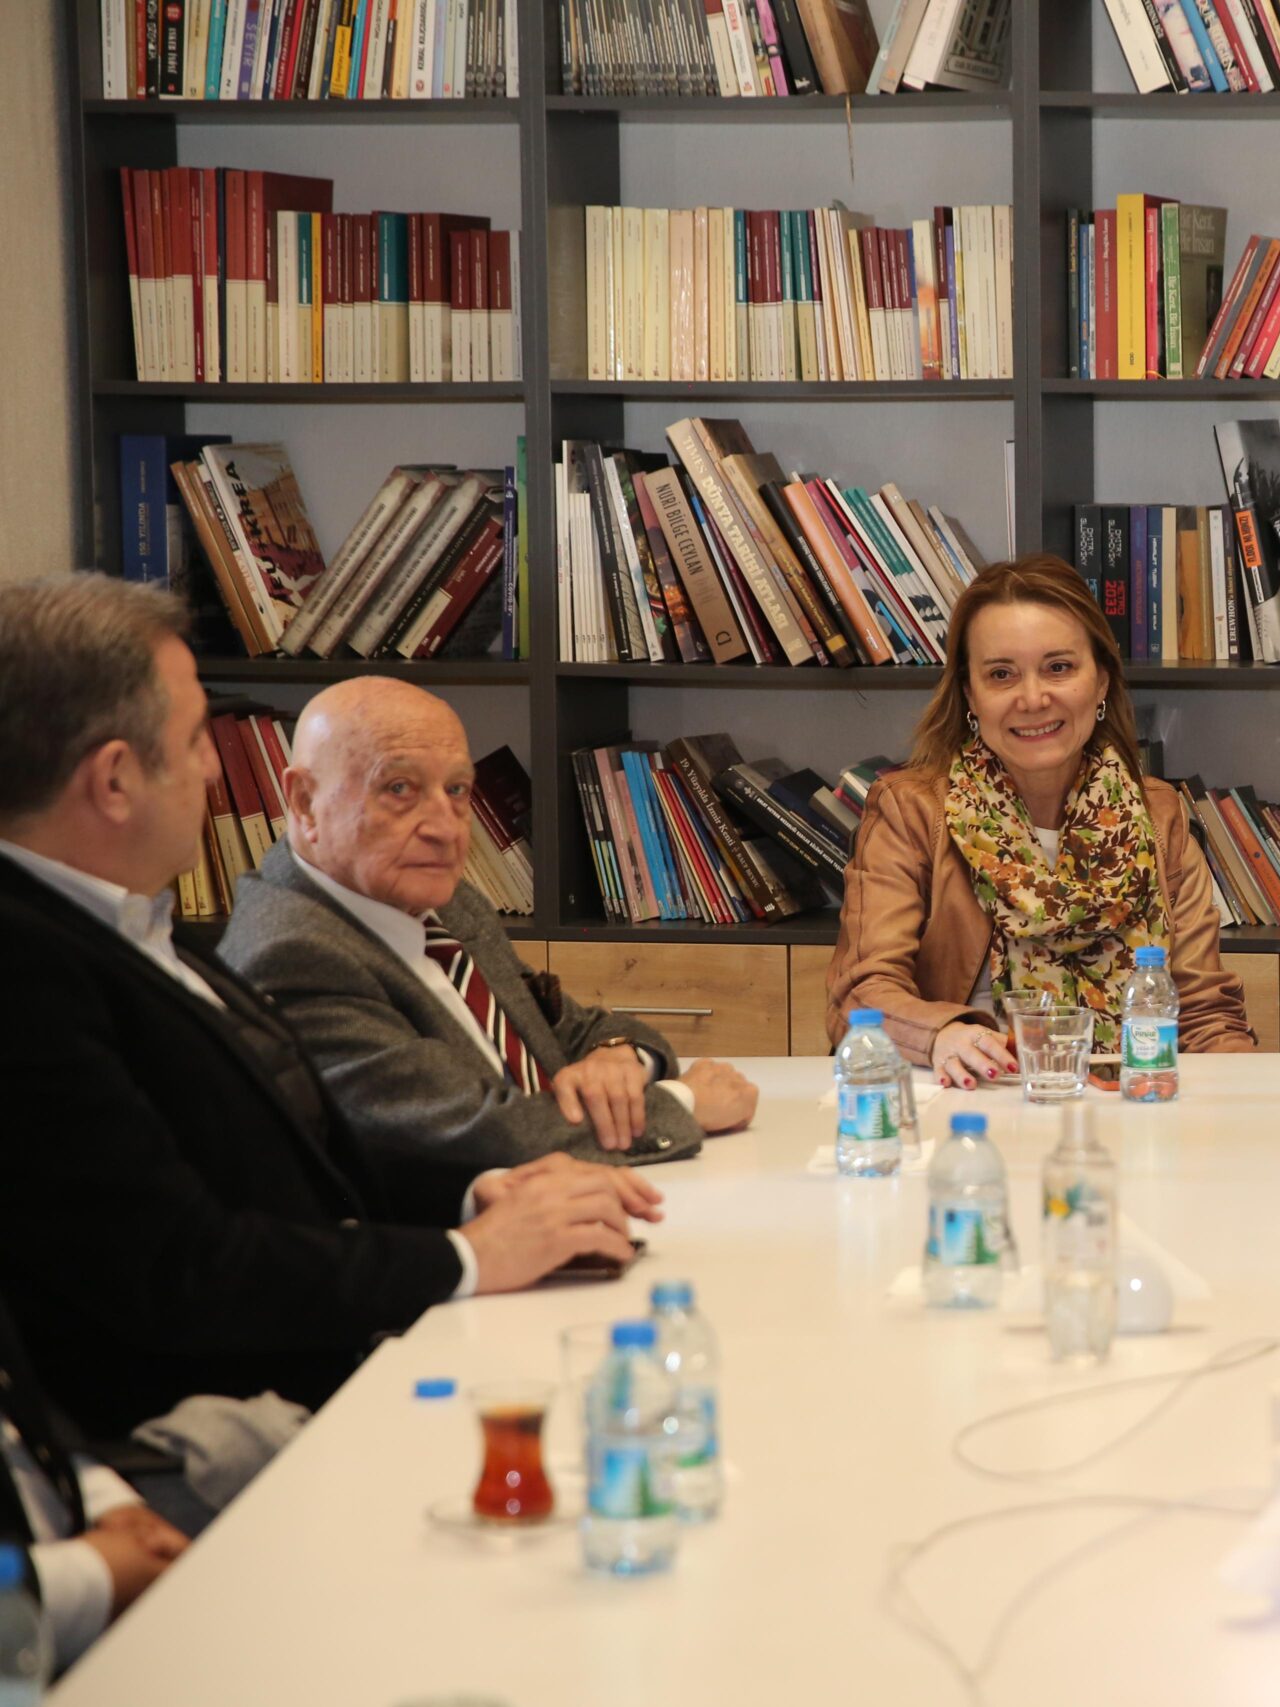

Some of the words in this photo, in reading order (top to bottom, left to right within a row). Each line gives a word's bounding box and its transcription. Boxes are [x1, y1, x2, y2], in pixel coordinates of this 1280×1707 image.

[654, 481, 679, 511] NURİ
[664, 506, 691, 539] BİLGE
[676, 536, 704, 576] CEYLAN
[699, 472, 739, 529] DÜNYA
[725, 521, 766, 580] TARİHİ
[752, 574, 790, 631] ATLASI
[1086, 527, 1094, 556] DMITRY
[1114, 528, 1122, 558] DMITRY
[1104, 578, 1117, 615] 2033
[1116, 579, 1125, 616] METRO
[677, 756, 692, 771] 19.
[681, 768, 712, 806] Yüzyılda
[703, 800, 725, 826] İzmir
[717, 822, 737, 847] Kenti
